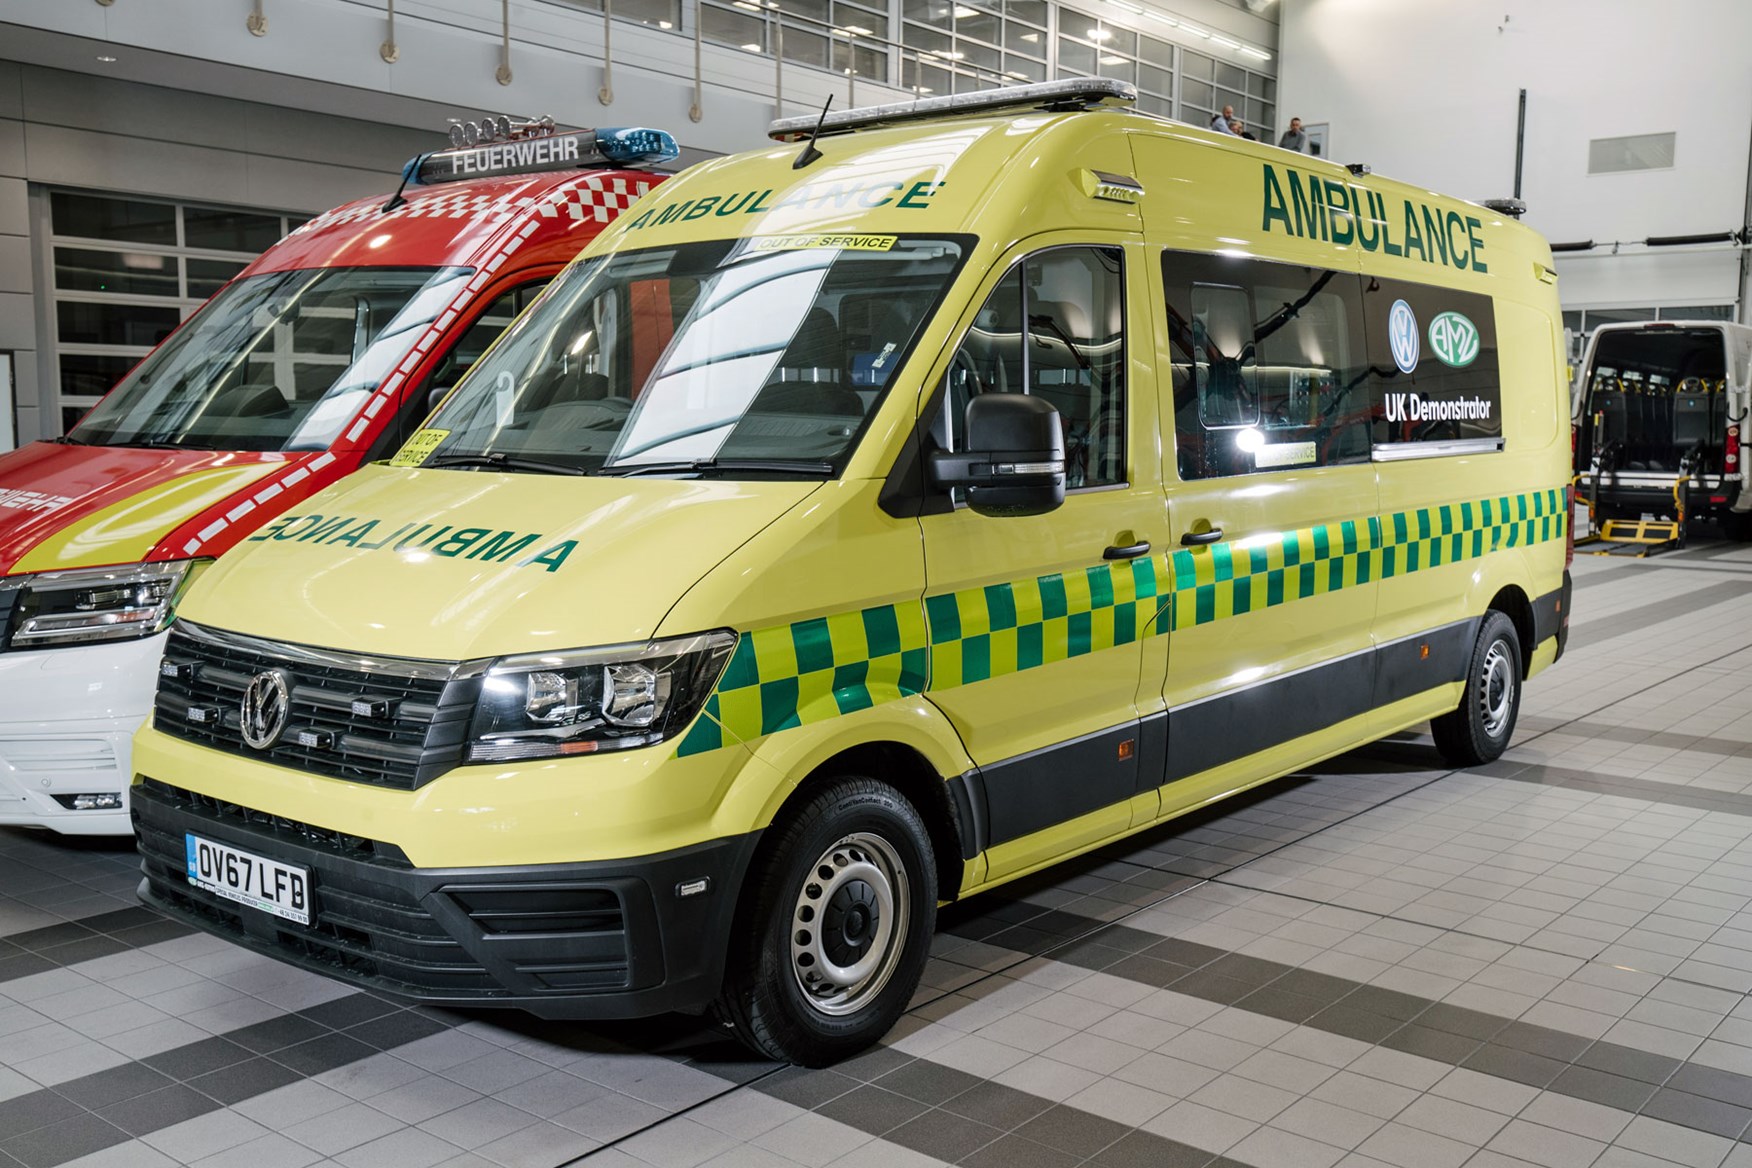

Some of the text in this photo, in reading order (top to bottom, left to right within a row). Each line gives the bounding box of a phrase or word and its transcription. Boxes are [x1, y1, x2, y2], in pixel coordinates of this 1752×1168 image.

[452, 136, 579, 175] FEUERWEHR
[624, 180, 946, 233] AMBULANCE
[1262, 163, 1488, 274] AMBULANCE
[759, 236, 894, 249] OUT OF SERVICE
[1430, 315, 1479, 364] AMZ
[1384, 392, 1492, 423] UK Demonstrator
[199, 843, 305, 911] OV67 LFD
